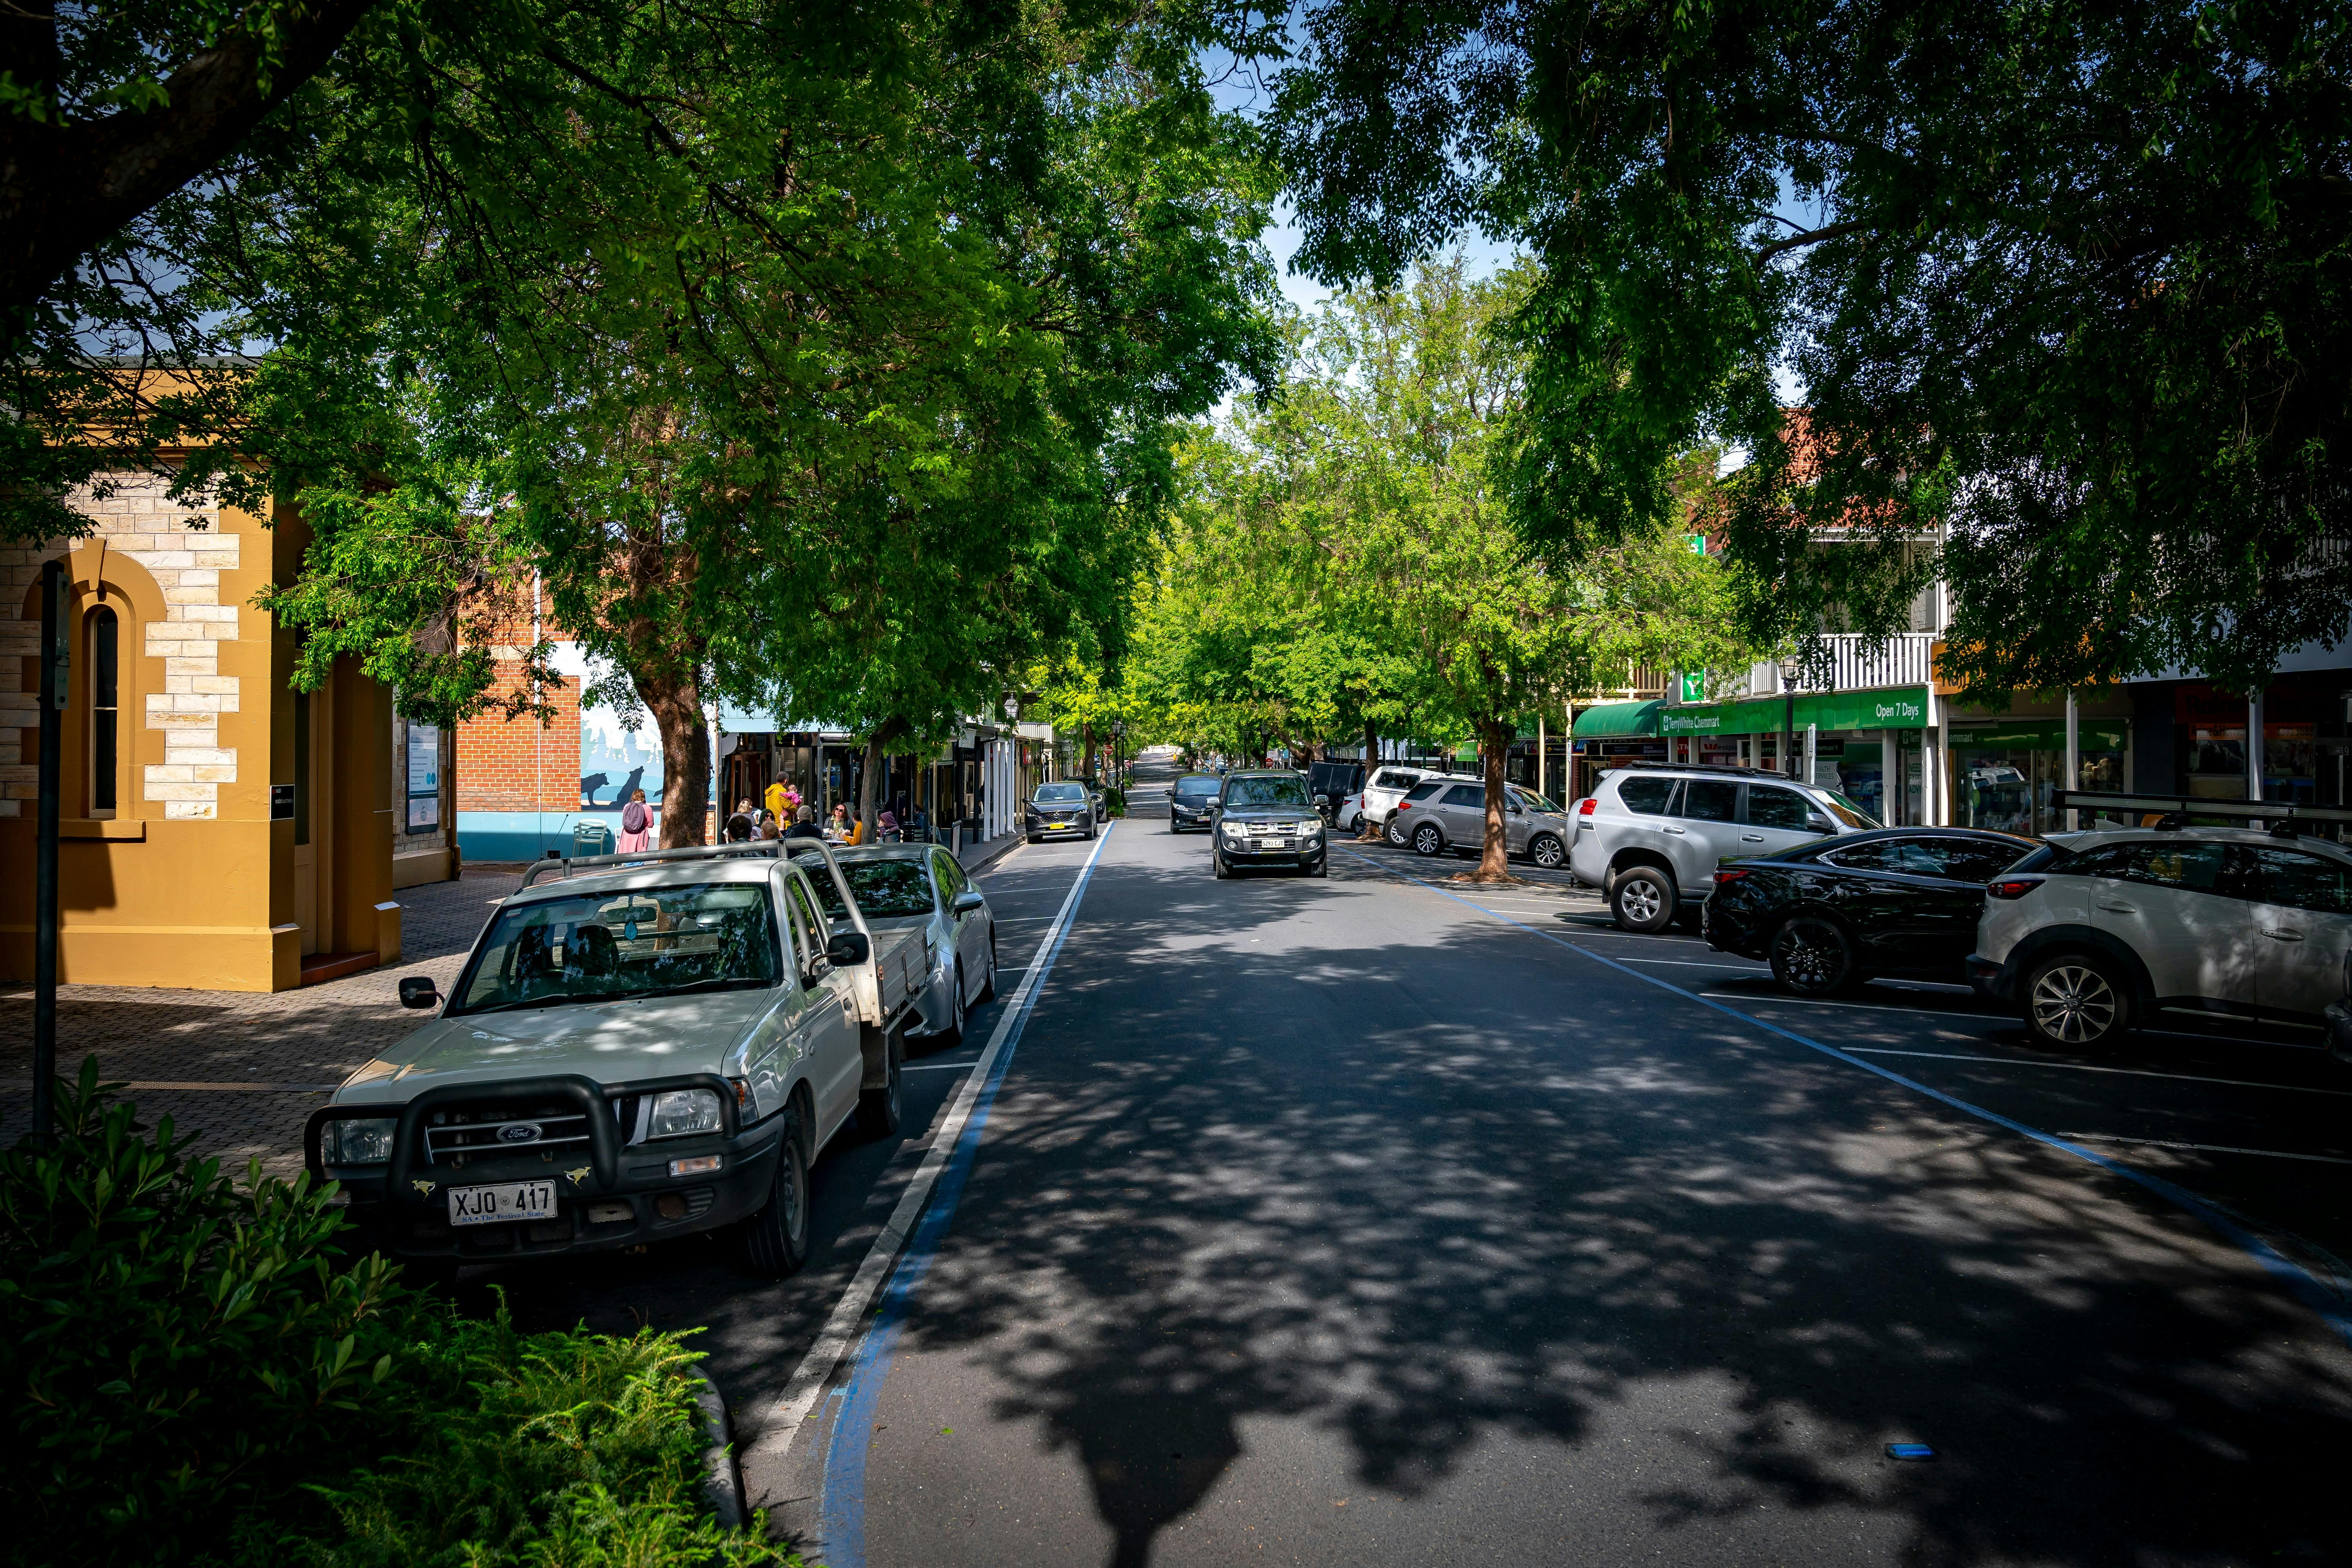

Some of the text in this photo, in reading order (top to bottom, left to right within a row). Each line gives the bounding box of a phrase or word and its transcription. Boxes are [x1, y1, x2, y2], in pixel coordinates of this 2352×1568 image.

[1876, 702, 1919, 721] Open 7 Days
[1669, 715, 1720, 732] TerryWhite Chemmart
[508, 1129, 529, 1138] Ford
[516, 1187, 548, 1210] 417
